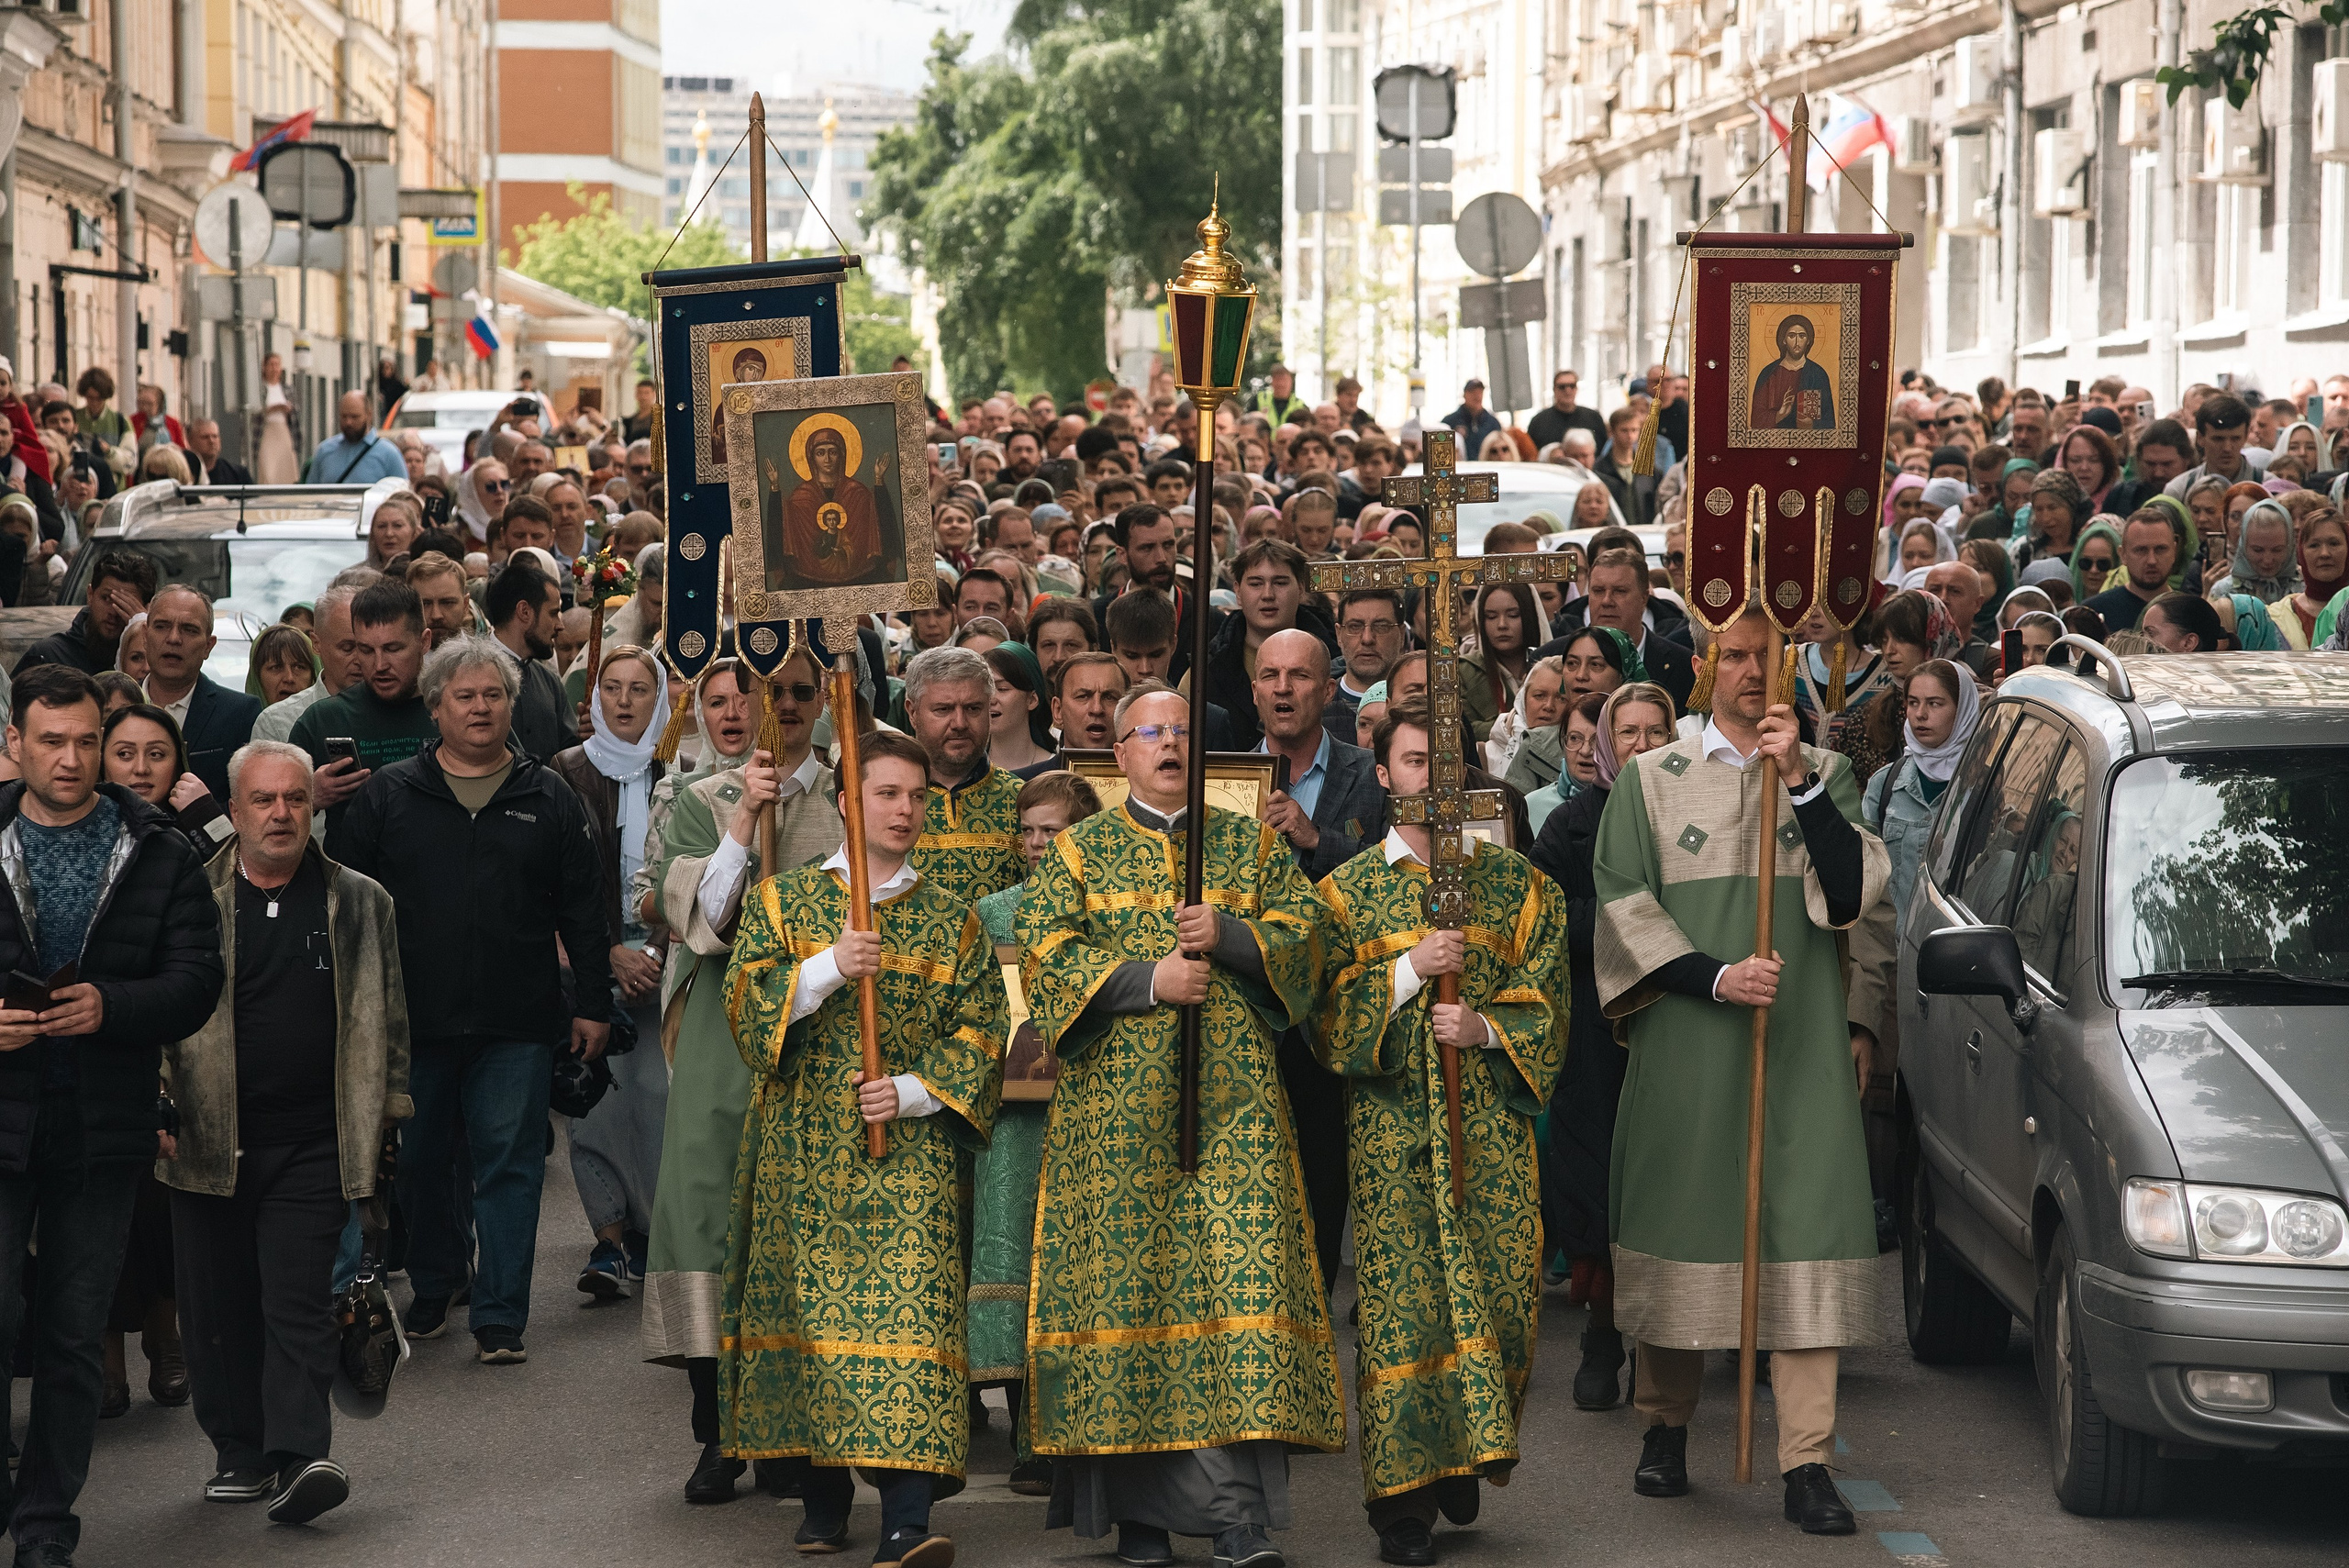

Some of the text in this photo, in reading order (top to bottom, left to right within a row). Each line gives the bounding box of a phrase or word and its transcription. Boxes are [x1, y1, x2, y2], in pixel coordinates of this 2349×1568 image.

[360, 740, 378, 748] Если
[381, 738, 420, 746] ополчится
[510, 809, 537, 820] Columbia
